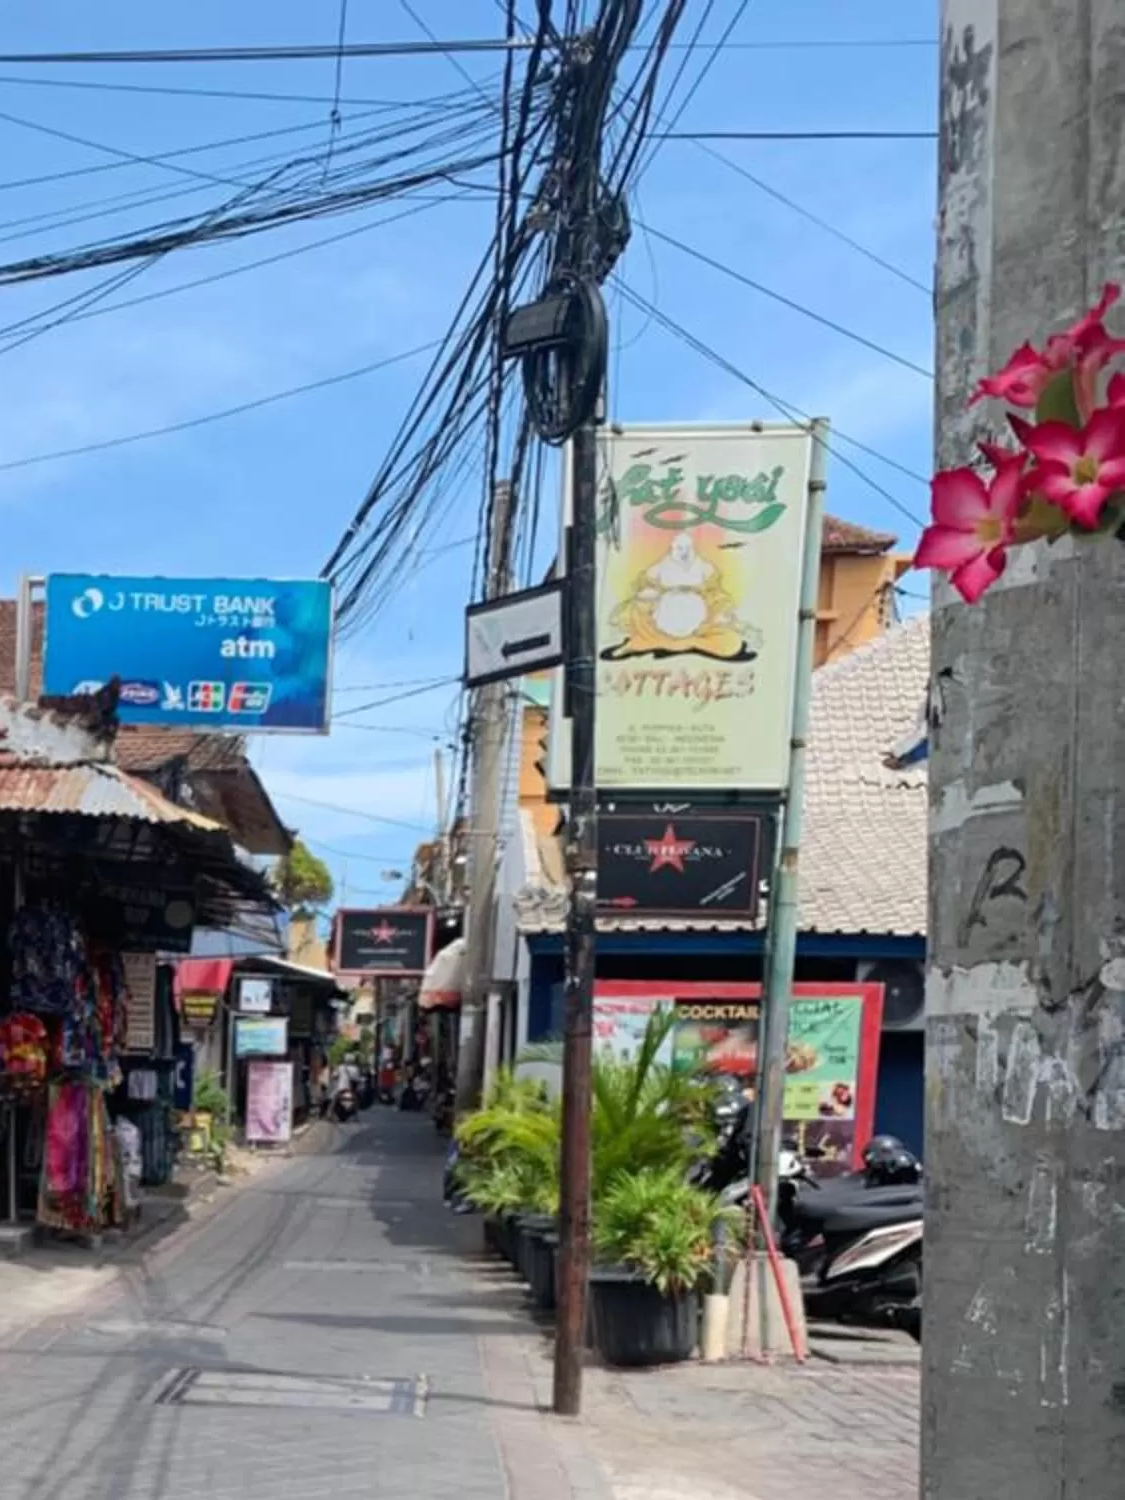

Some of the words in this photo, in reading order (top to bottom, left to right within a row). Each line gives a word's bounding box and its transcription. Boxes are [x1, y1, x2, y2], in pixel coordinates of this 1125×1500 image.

[129, 591, 207, 614] TRUST
[213, 594, 276, 615] BANK
[220, 635, 276, 659] atm
